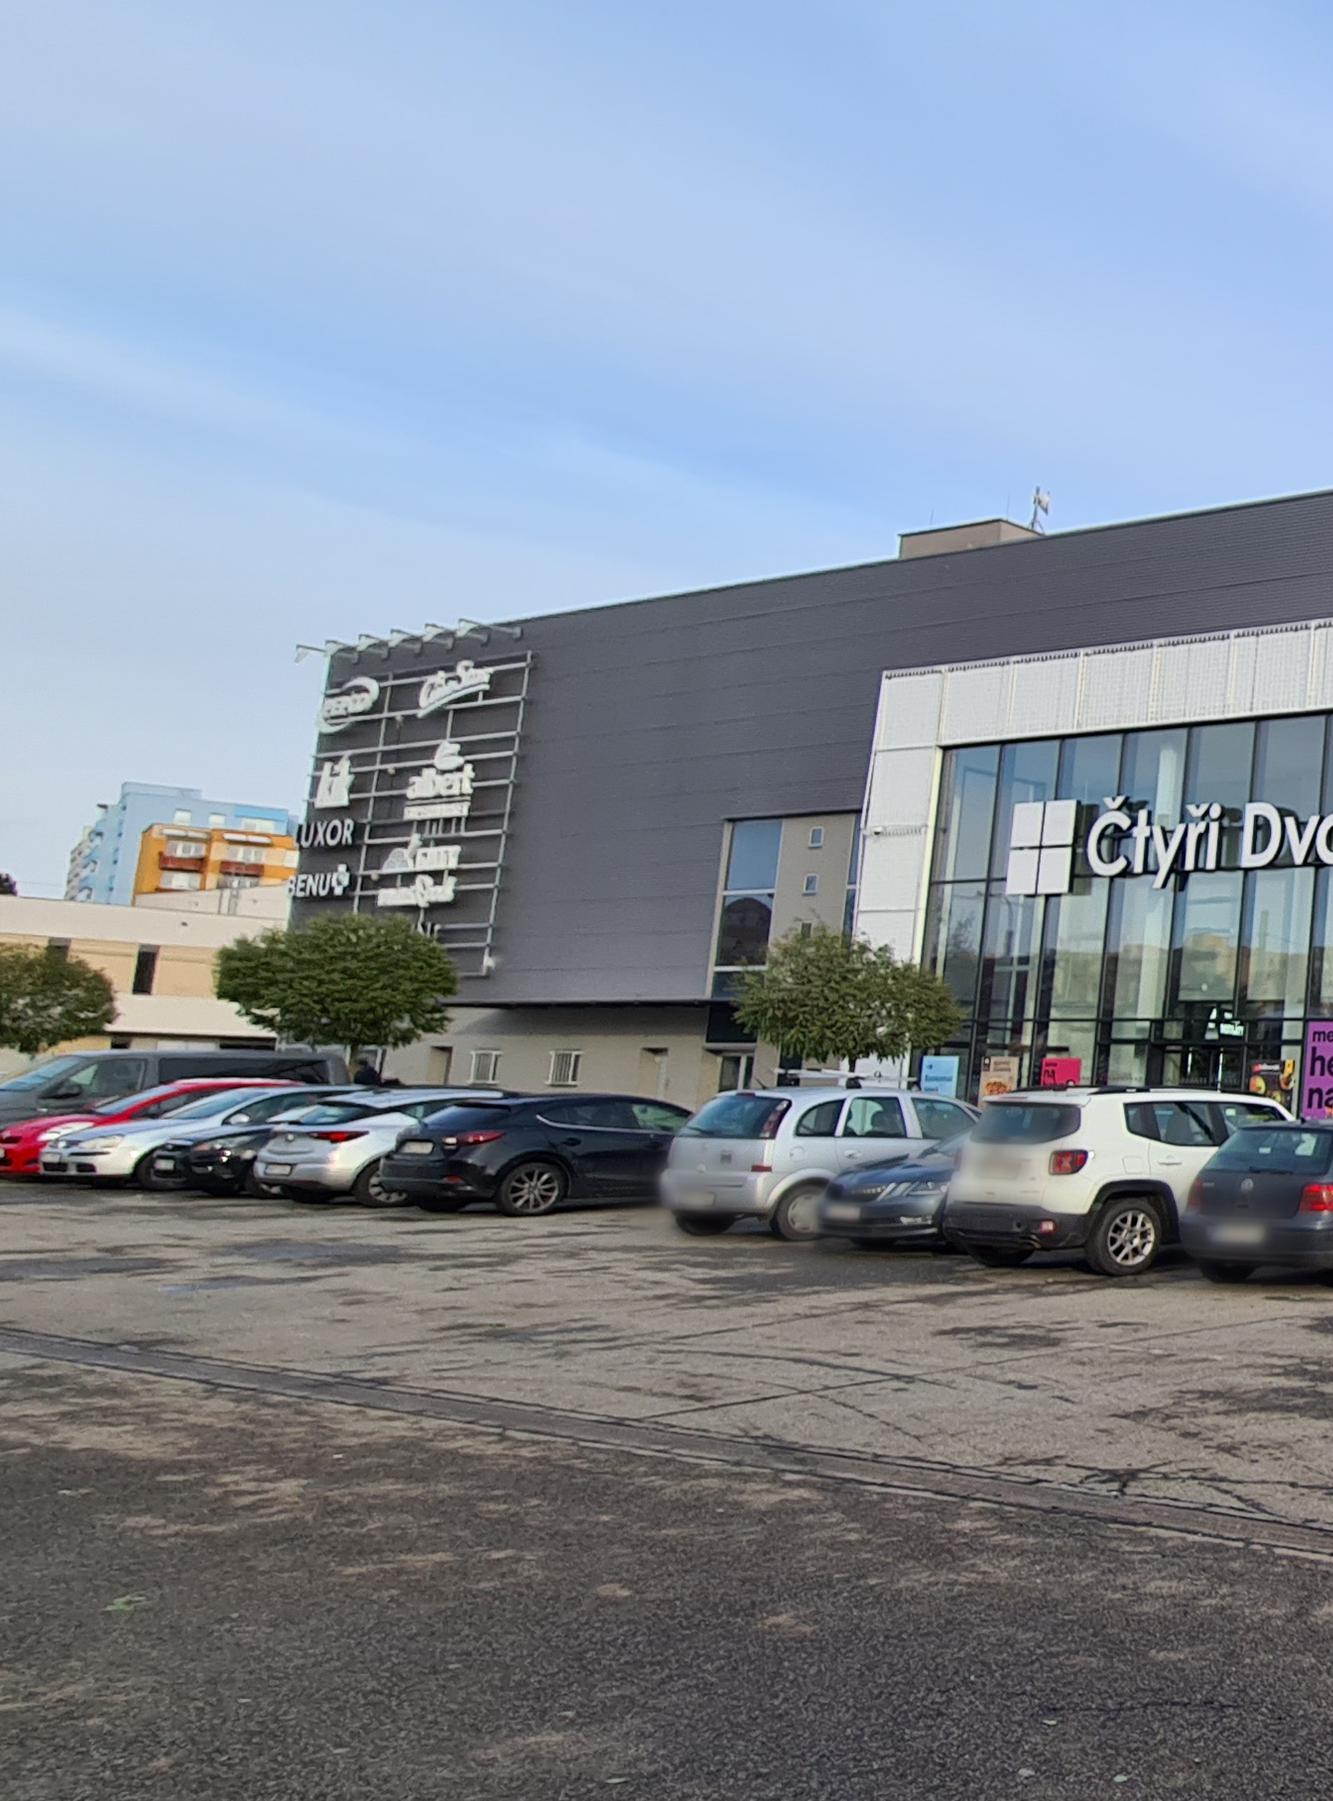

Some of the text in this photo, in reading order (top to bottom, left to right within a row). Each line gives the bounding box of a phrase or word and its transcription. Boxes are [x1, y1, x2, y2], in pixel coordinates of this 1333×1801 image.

[407, 763, 475, 799] albert
[1087, 795, 1224, 889] Čtyři
[287, 872, 331, 897] BENU
